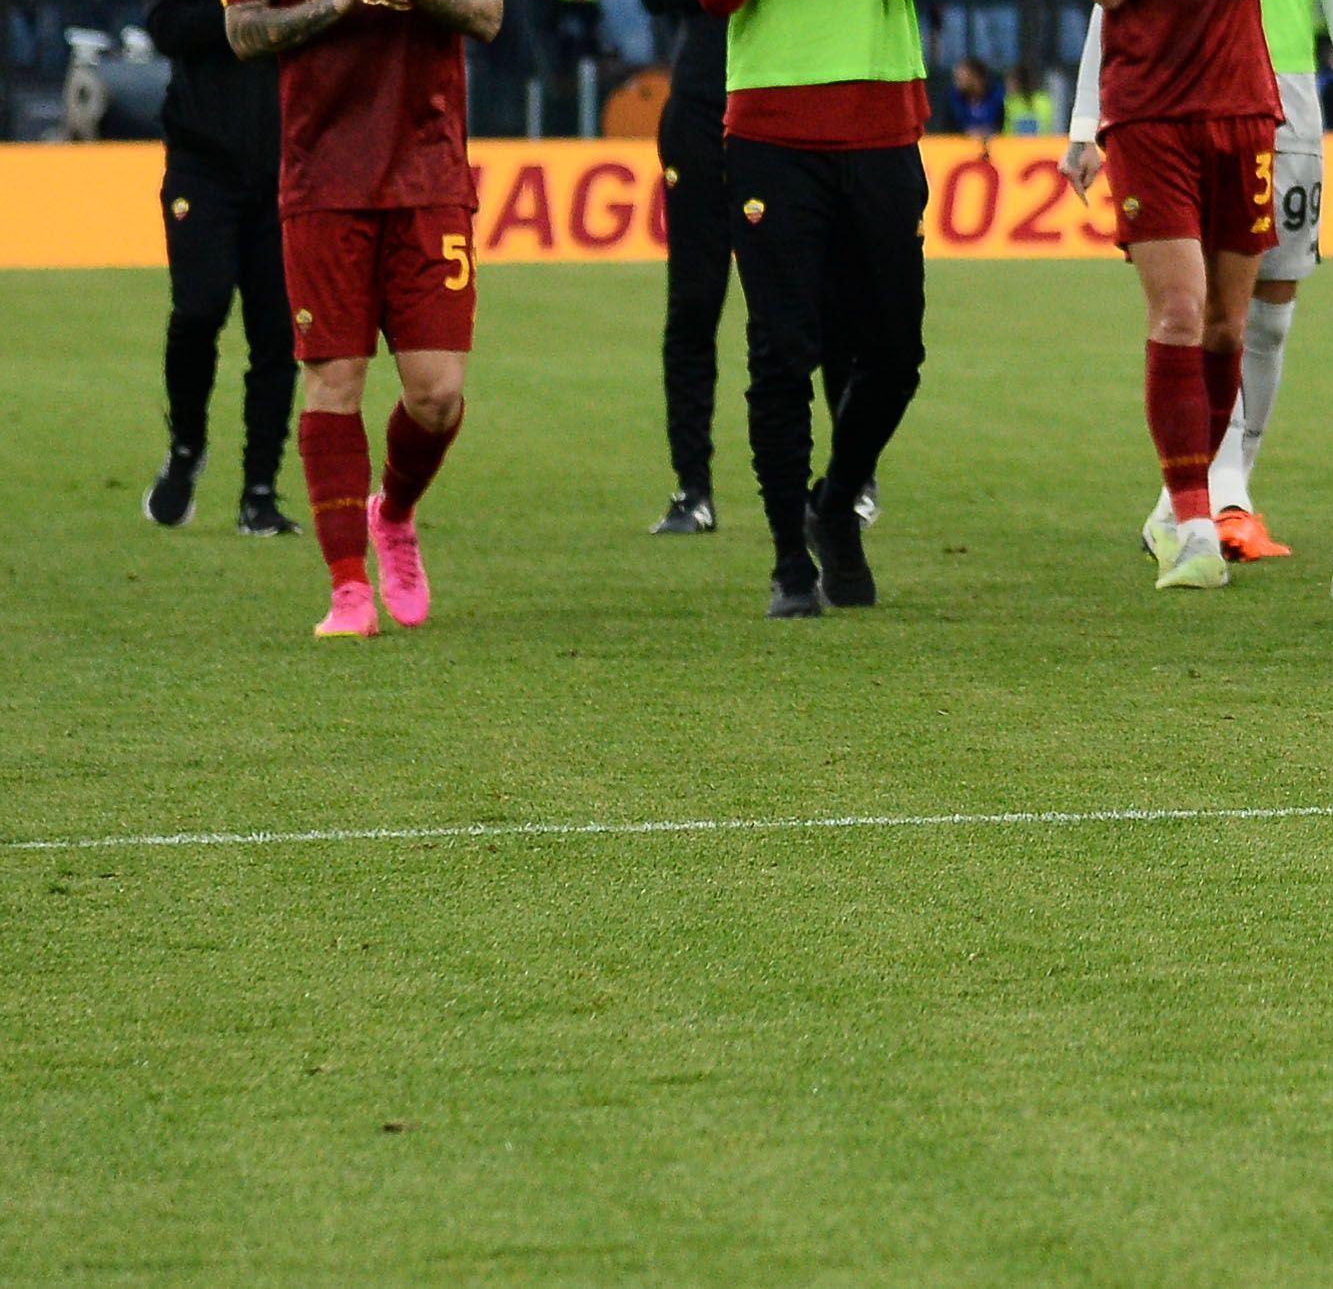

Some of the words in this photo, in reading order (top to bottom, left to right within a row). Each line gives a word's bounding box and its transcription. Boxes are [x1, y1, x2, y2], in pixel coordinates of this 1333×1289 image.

[470, 163, 668, 251] AG
[1253, 153, 1272, 205] 3
[442, 233, 478, 291] 5
